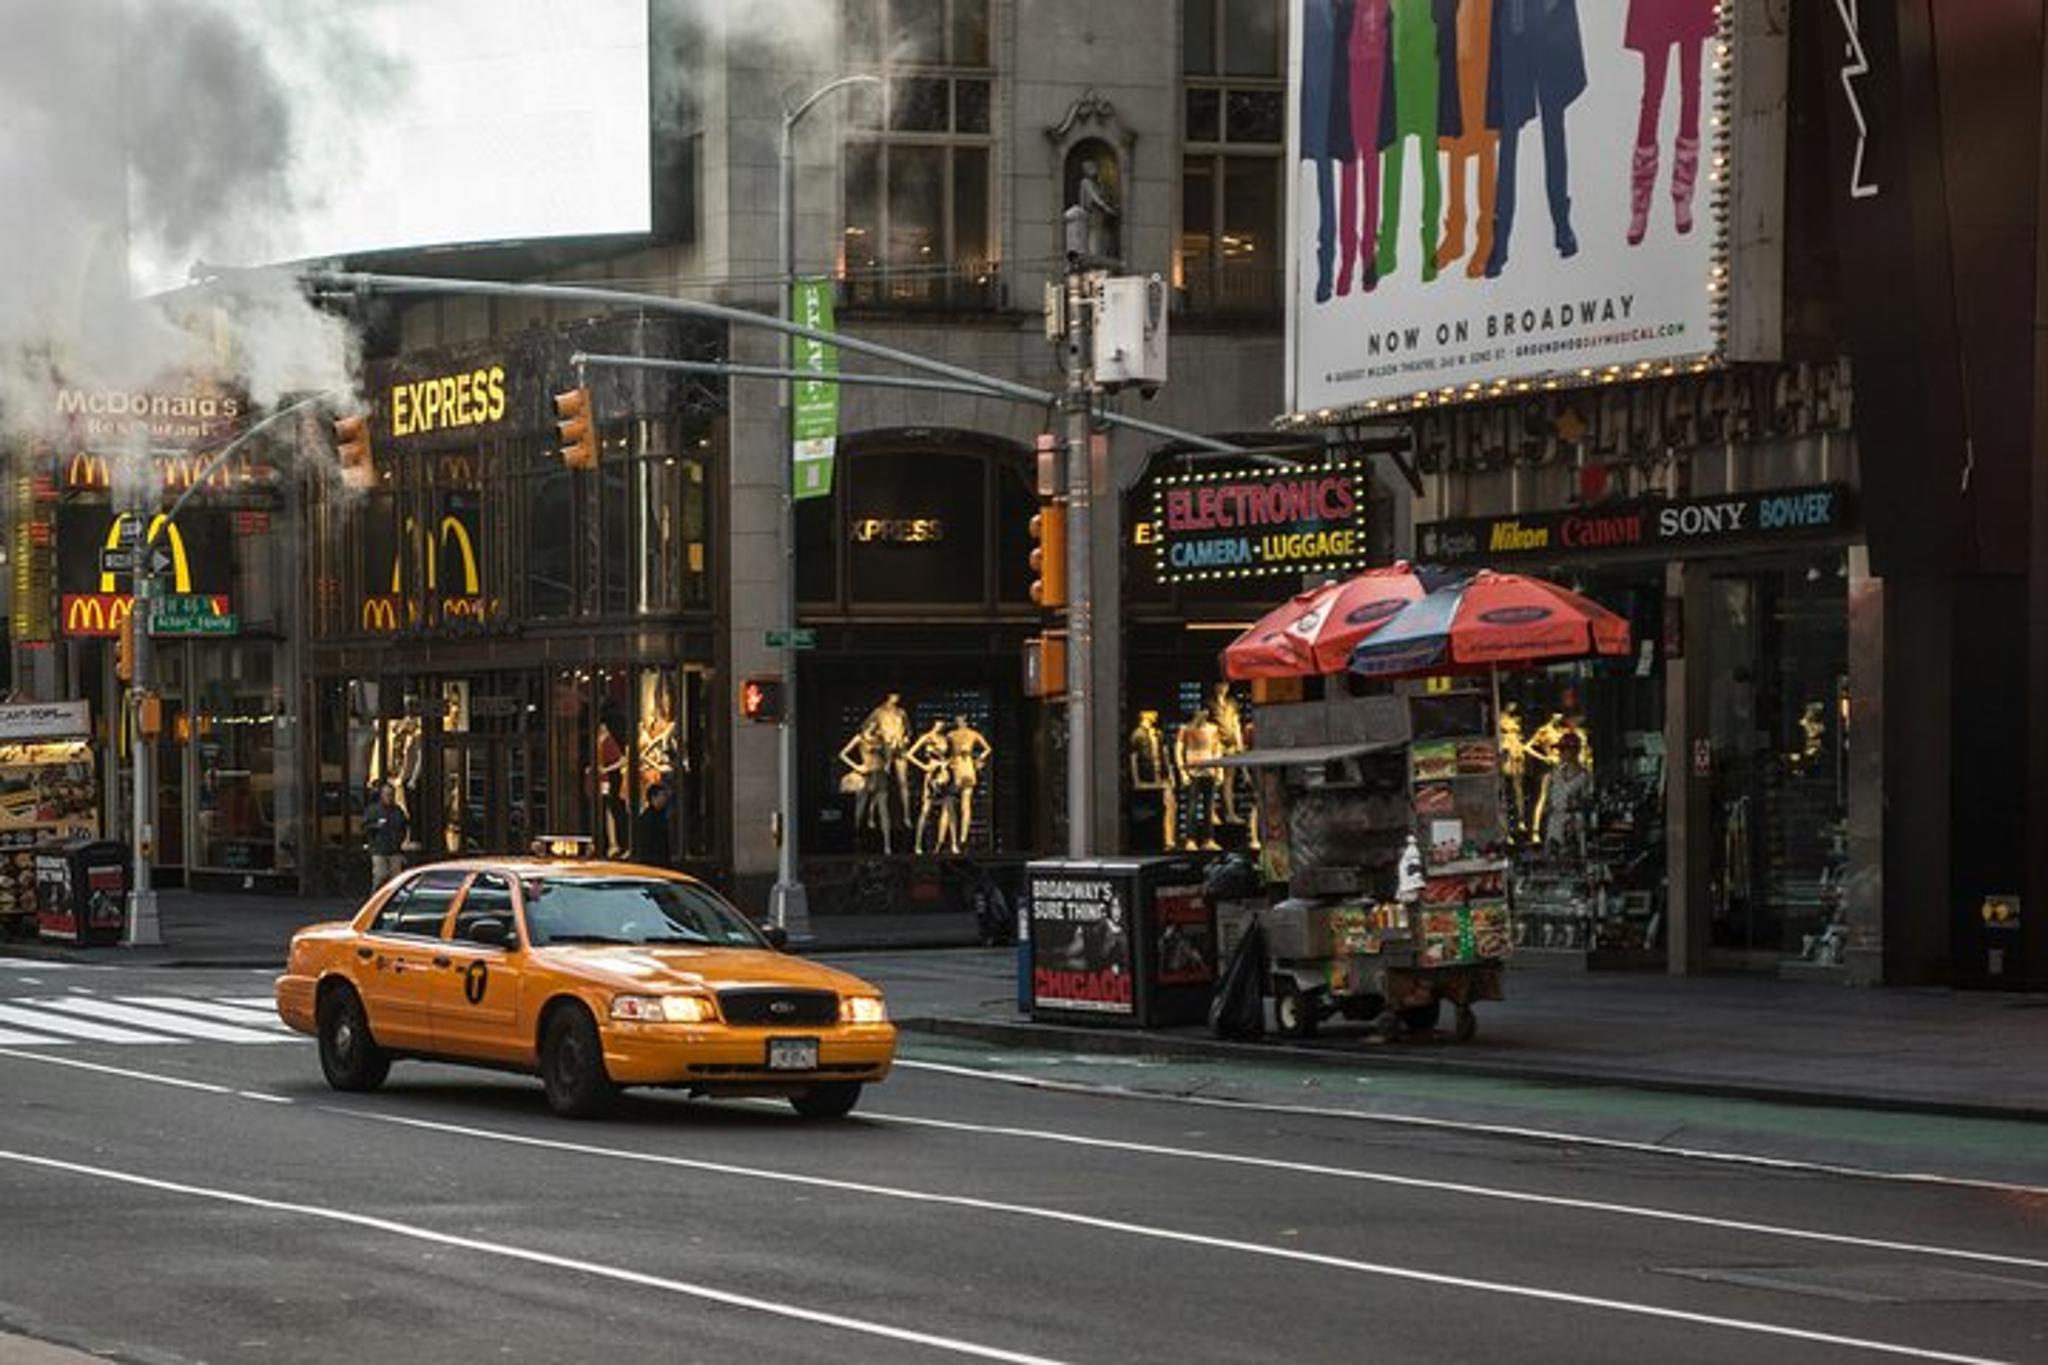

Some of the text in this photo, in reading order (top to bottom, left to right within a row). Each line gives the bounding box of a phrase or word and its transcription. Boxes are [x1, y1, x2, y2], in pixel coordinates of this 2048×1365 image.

[1367, 294, 1634, 357] NOW ON BROADWAY
[392, 365, 505, 436] EXPRESS
[1167, 477, 1356, 530] ELECTRONICS
[1659, 503, 1748, 537] SONY
[1759, 494, 1832, 530] BOWER
[850, 518, 942, 542] XPRESS
[1490, 522, 1549, 553] Nikon
[1561, 515, 1641, 547] Canon
[1170, 530, 1355, 568] CAMERA LUGGAGE
[1032, 880, 1113, 902] BROADWAY'S
[1033, 901, 1064, 920] SURE
